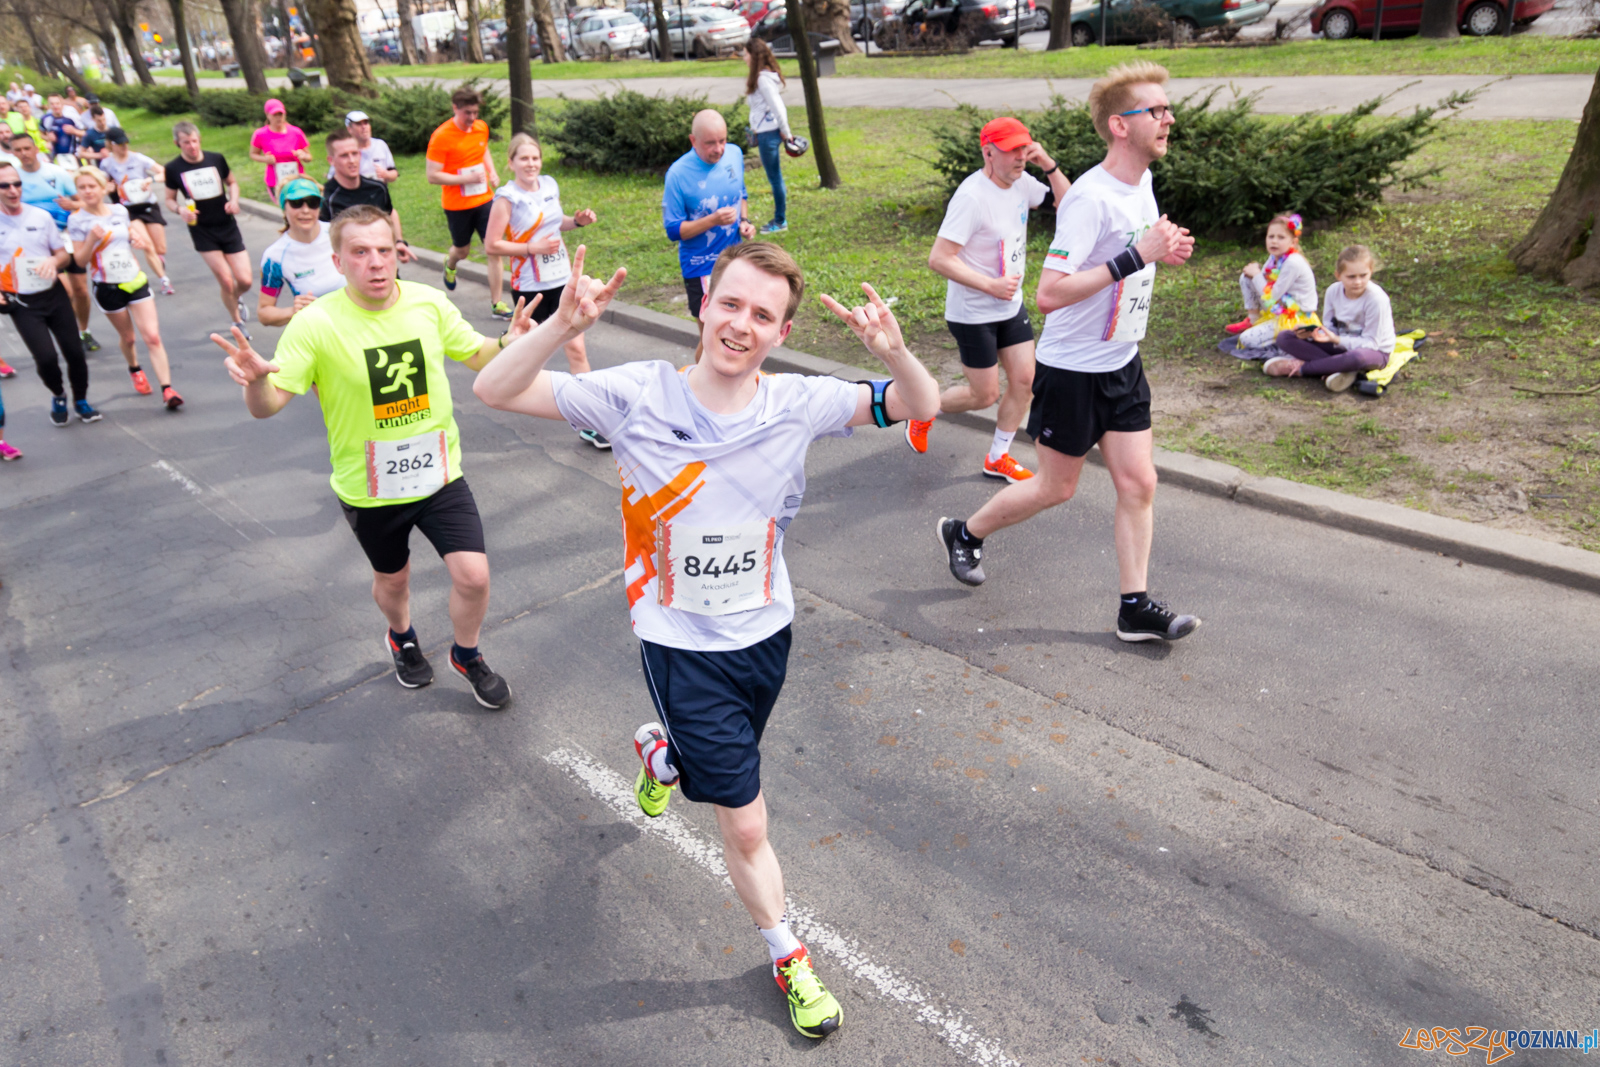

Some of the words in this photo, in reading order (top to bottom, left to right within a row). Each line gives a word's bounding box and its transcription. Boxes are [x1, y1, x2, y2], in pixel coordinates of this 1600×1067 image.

[386, 398, 420, 416] night
[376, 409, 431, 429] runners
[386, 453, 434, 475] 2862
[684, 549, 756, 579] 8445
[700, 580, 740, 591] Arkadiusz
